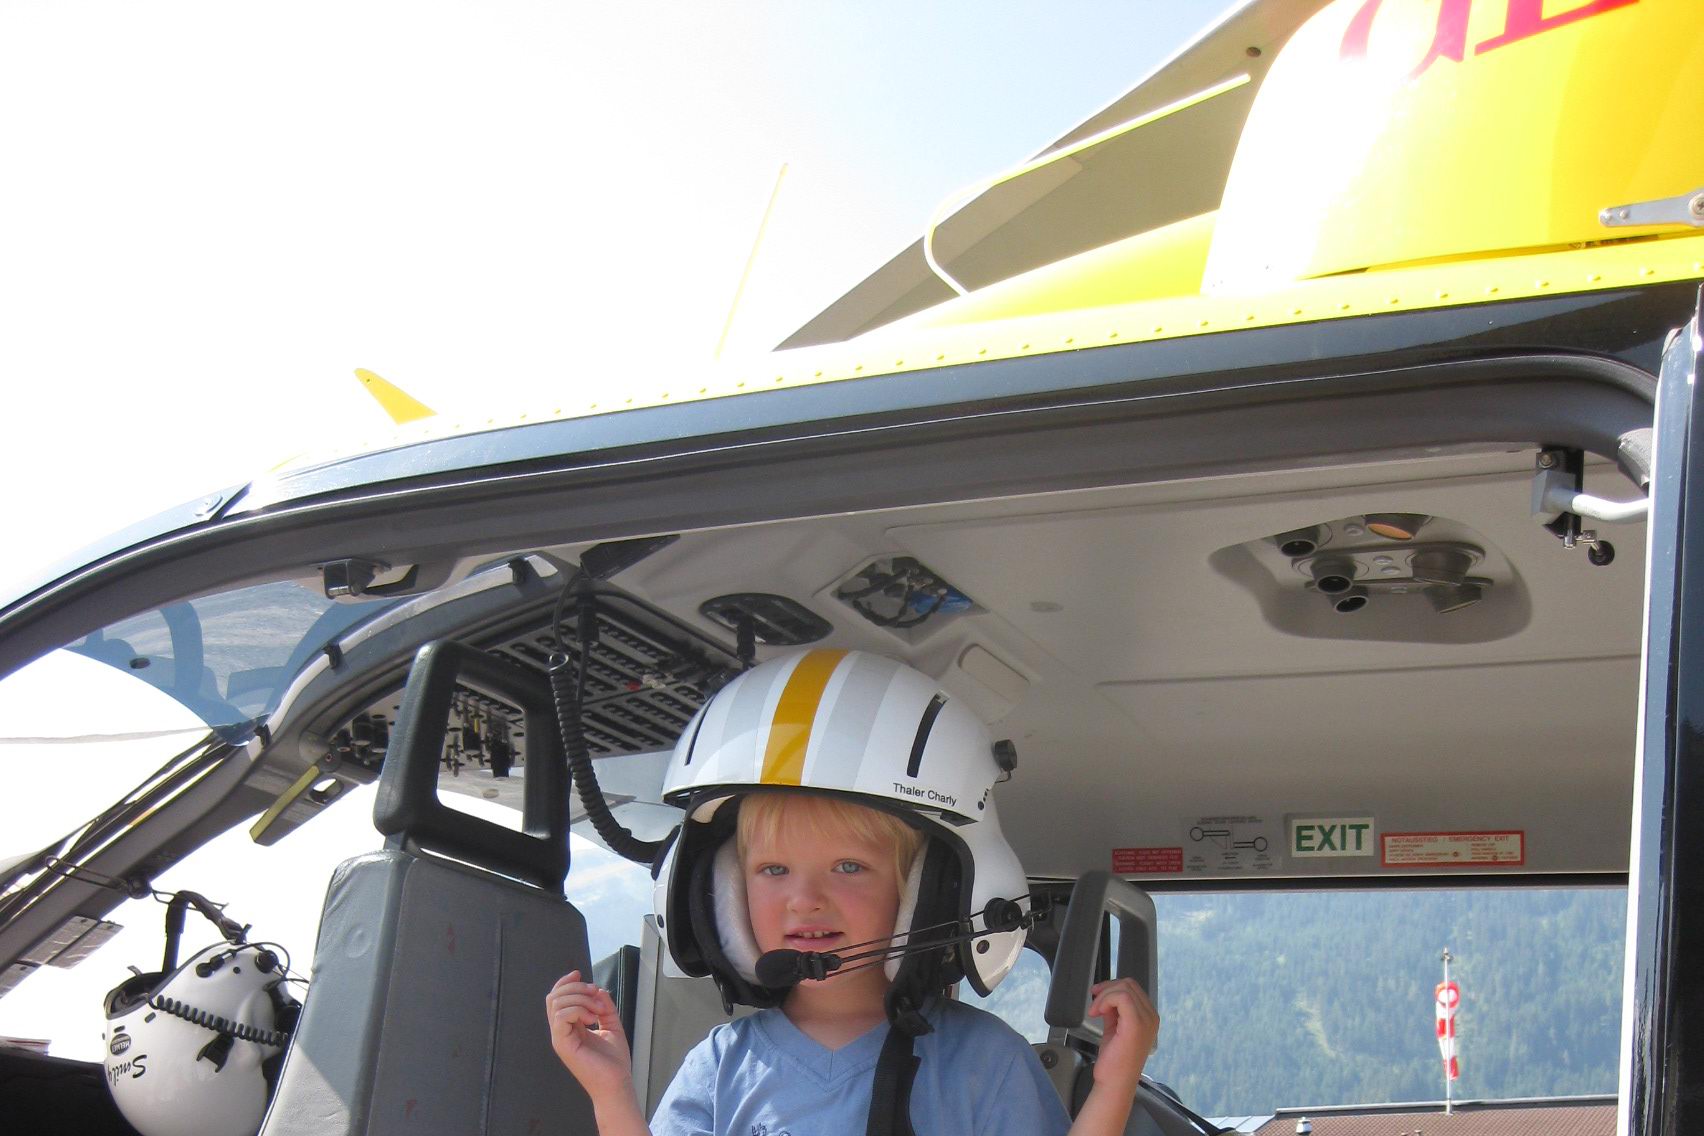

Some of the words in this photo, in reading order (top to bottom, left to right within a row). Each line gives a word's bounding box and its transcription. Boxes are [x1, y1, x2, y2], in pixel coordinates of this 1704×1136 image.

[893, 783, 925, 797] Thaler
[928, 790, 957, 807] Charly
[1295, 823, 1370, 852] EXIT
